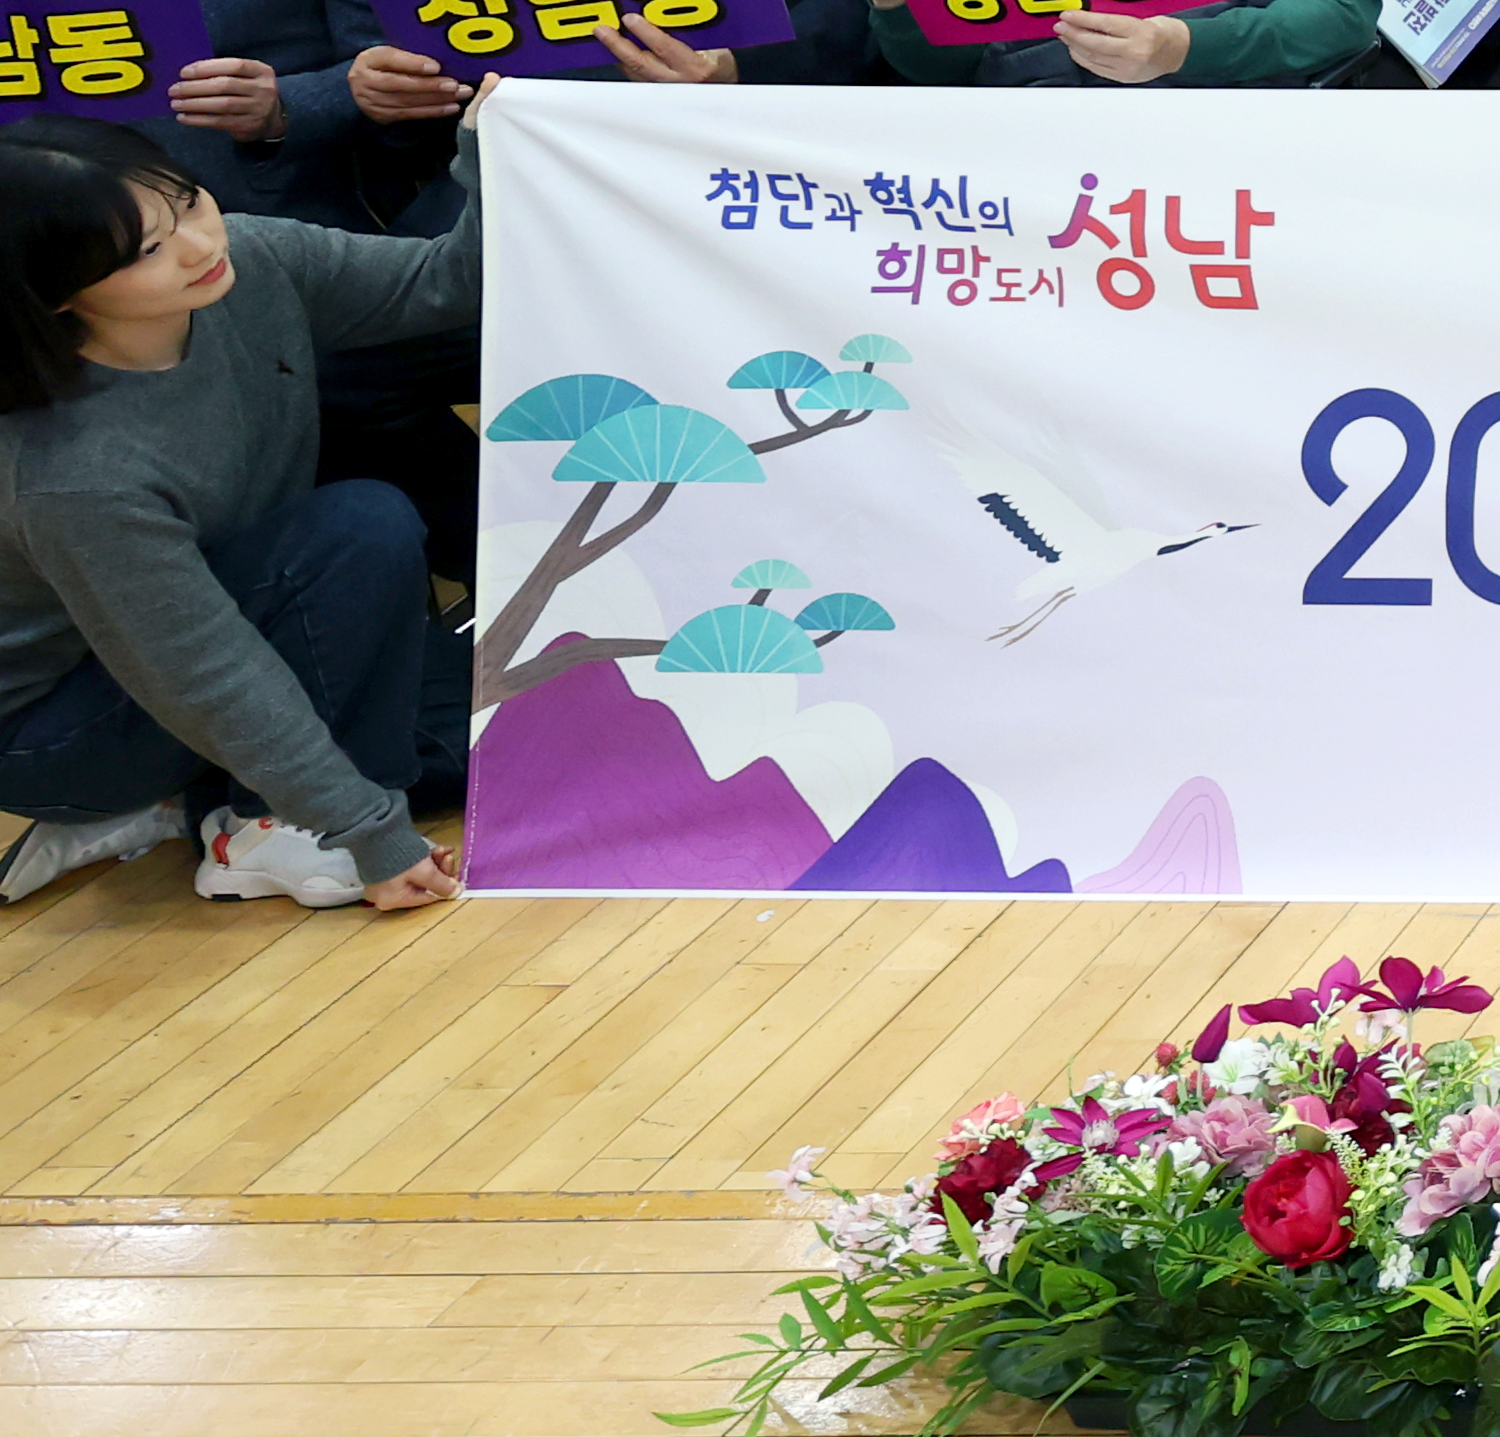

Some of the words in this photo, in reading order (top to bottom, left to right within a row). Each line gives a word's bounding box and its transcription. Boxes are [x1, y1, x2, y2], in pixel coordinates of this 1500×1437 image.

[1403, 0, 1439, 35] 발전
[705, 168, 863, 232] 첨단과
[863, 172, 1014, 236] 혁신의
[1048, 173, 1274, 310] 성남
[870, 245, 1066, 307] 희망도시
